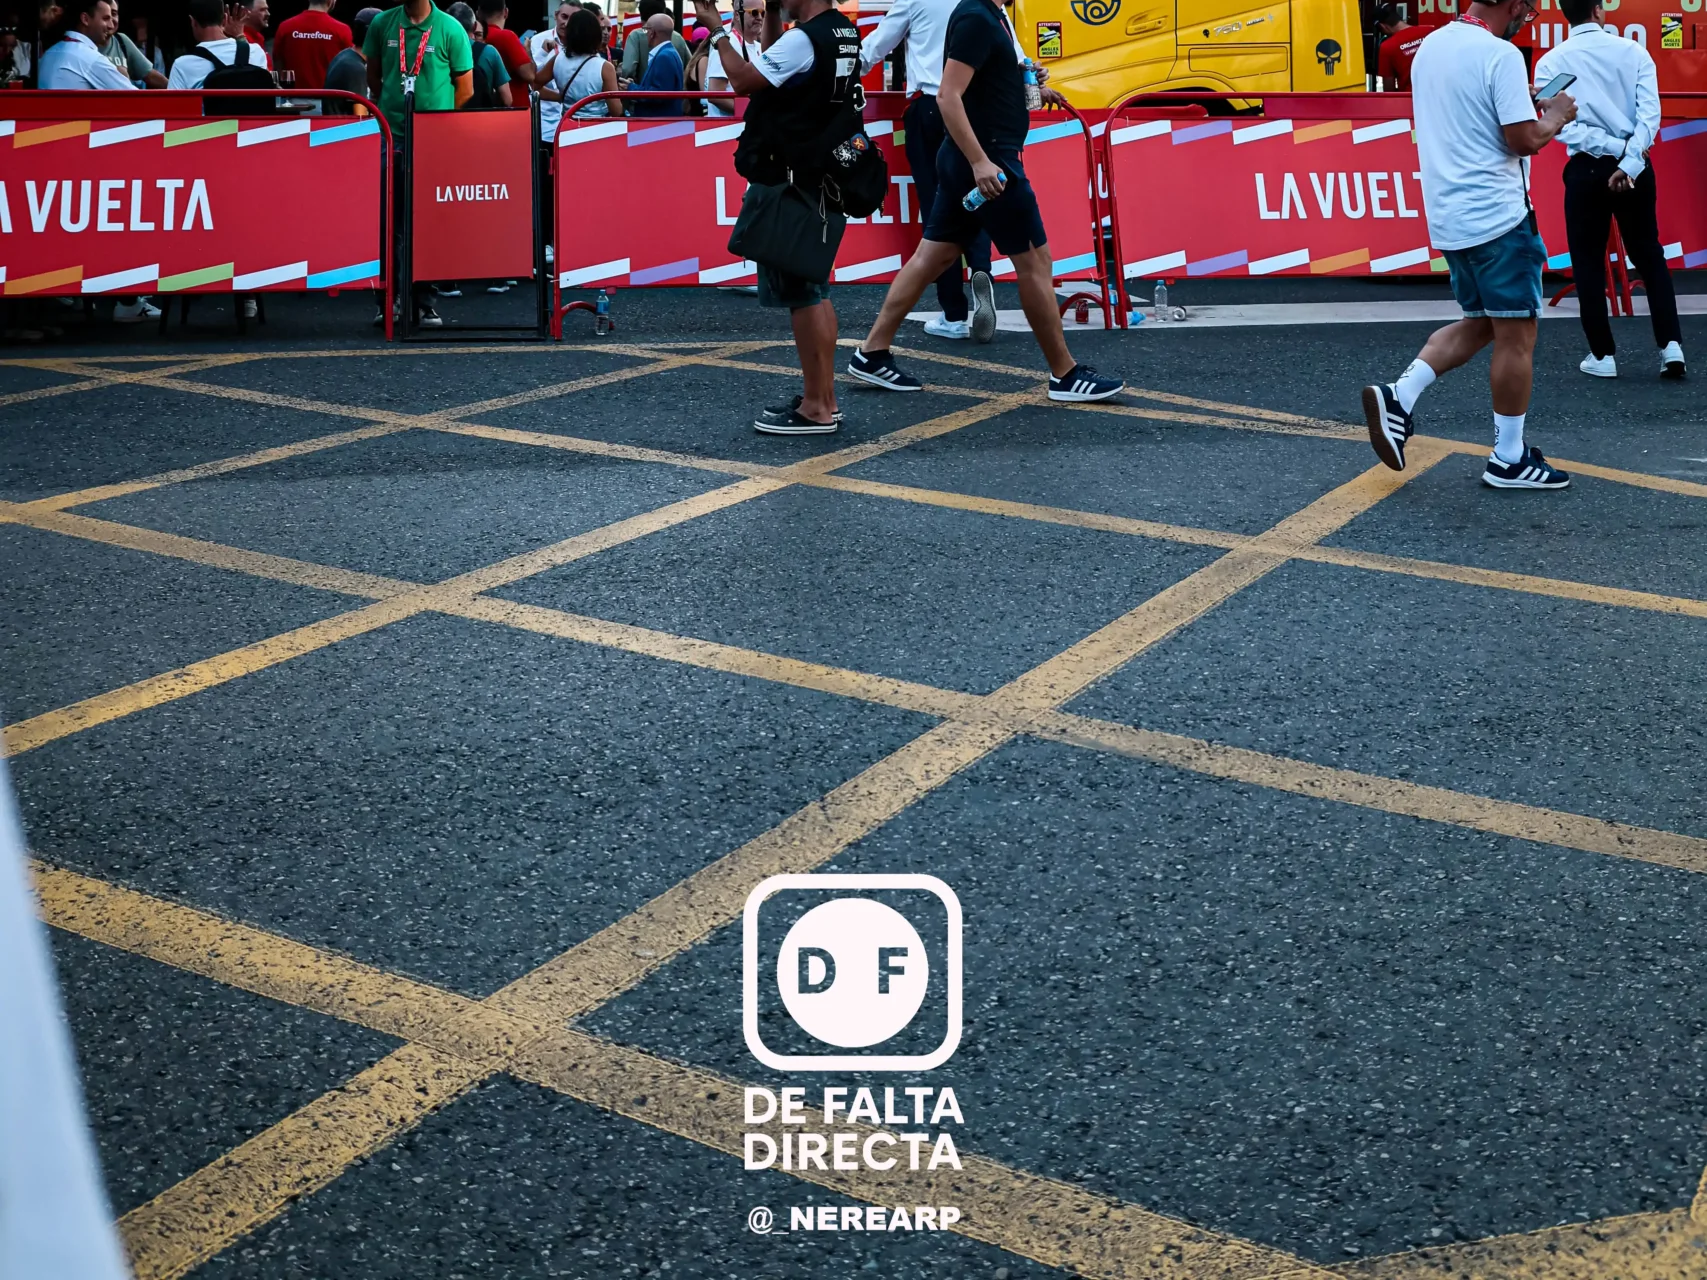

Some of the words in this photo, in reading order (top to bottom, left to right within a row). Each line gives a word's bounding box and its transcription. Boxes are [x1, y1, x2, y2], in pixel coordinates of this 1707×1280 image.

[292, 30, 333, 41] Carrefour
[25, 178, 214, 233] VUELTA
[436, 186, 454, 202] LA
[455, 183, 509, 201] VUELTA
[1254, 172, 1308, 220] LA
